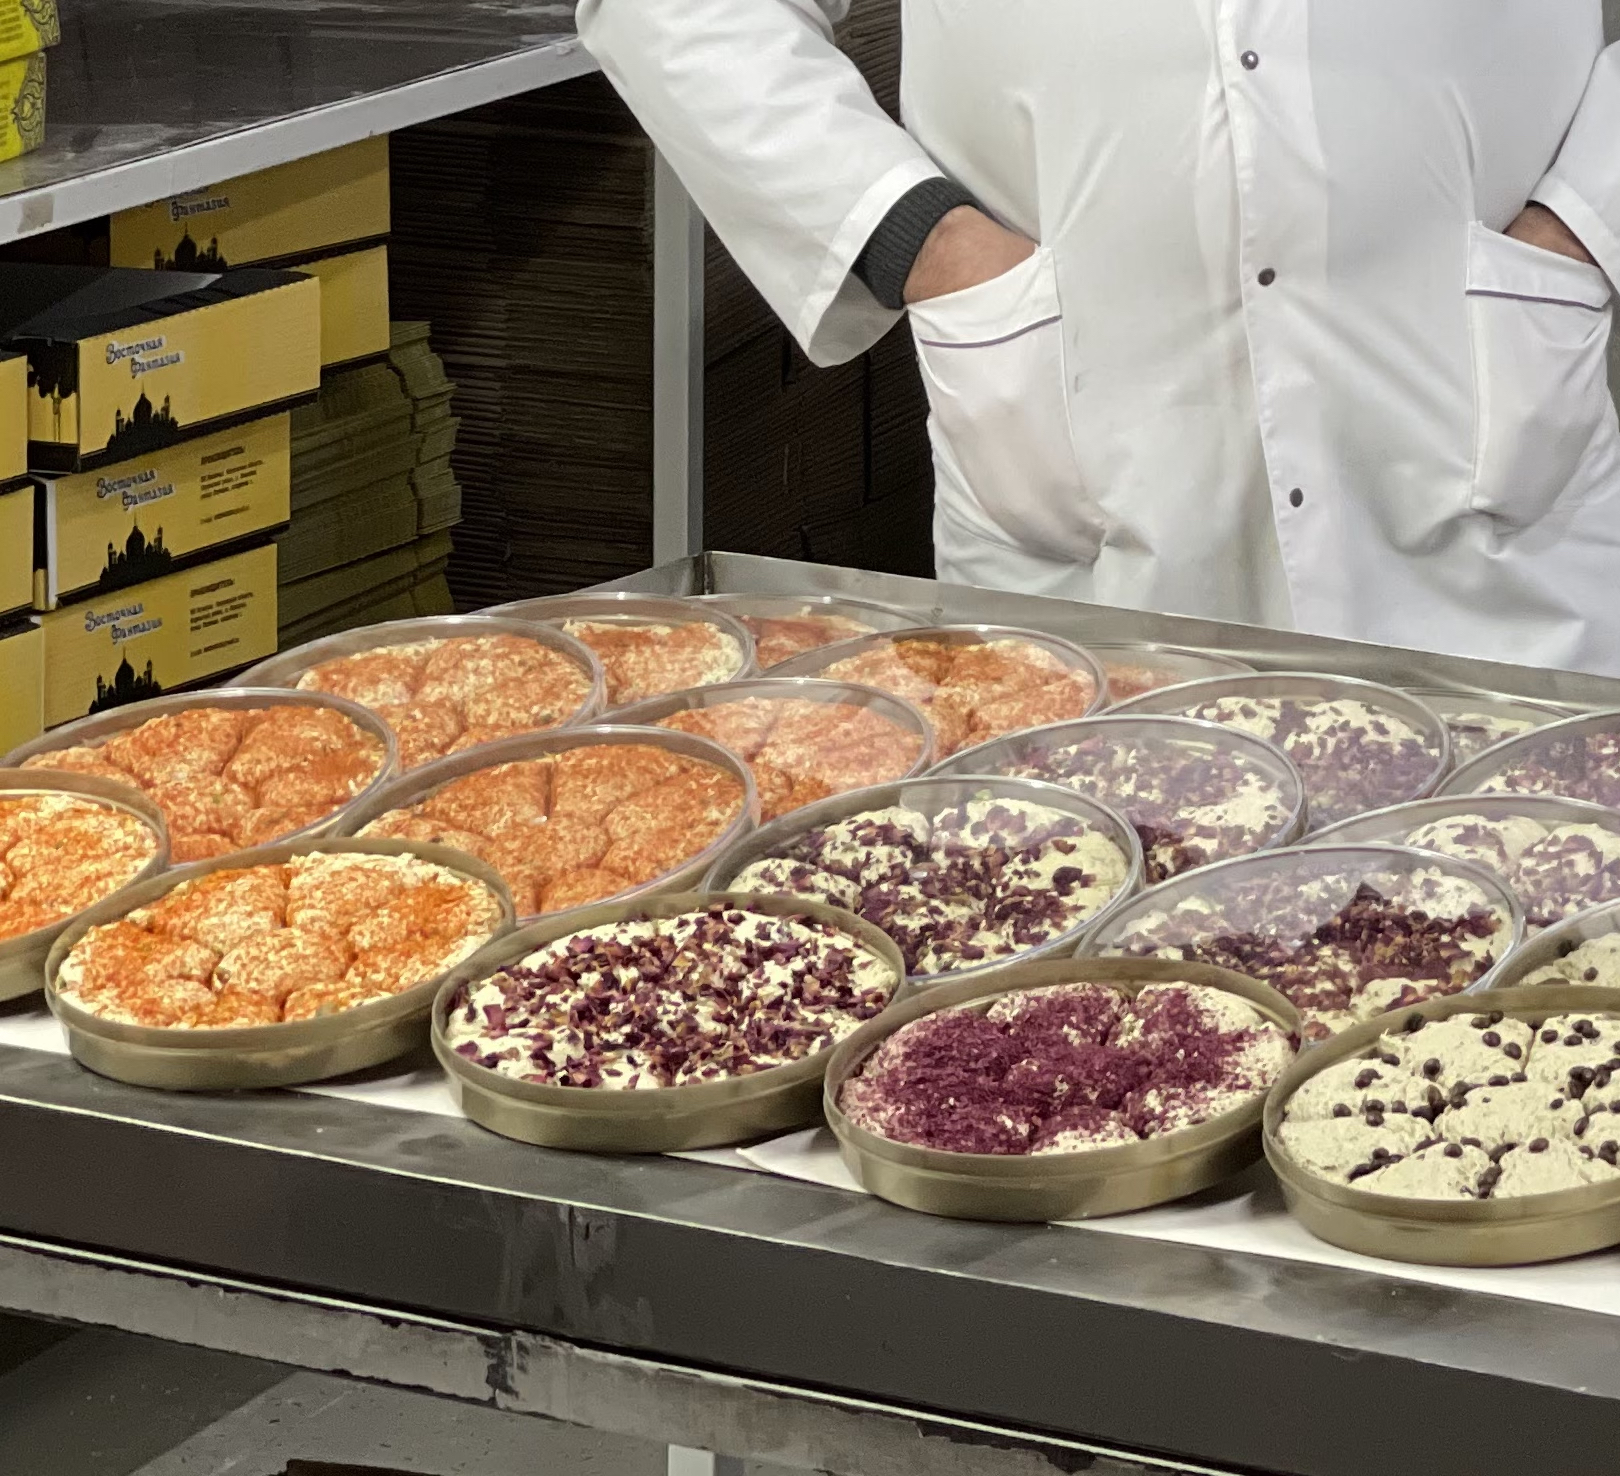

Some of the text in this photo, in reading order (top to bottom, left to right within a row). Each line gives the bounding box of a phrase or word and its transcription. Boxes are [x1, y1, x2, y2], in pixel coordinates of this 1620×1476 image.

[105, 337, 164, 365] Восточная
[131, 352, 181, 380] Фантазия
[96, 469, 156, 499] Восточная
[122, 483, 174, 512] Фантазия
[84, 603, 144, 632] Восточная
[111, 617, 163, 645] Фантазия
